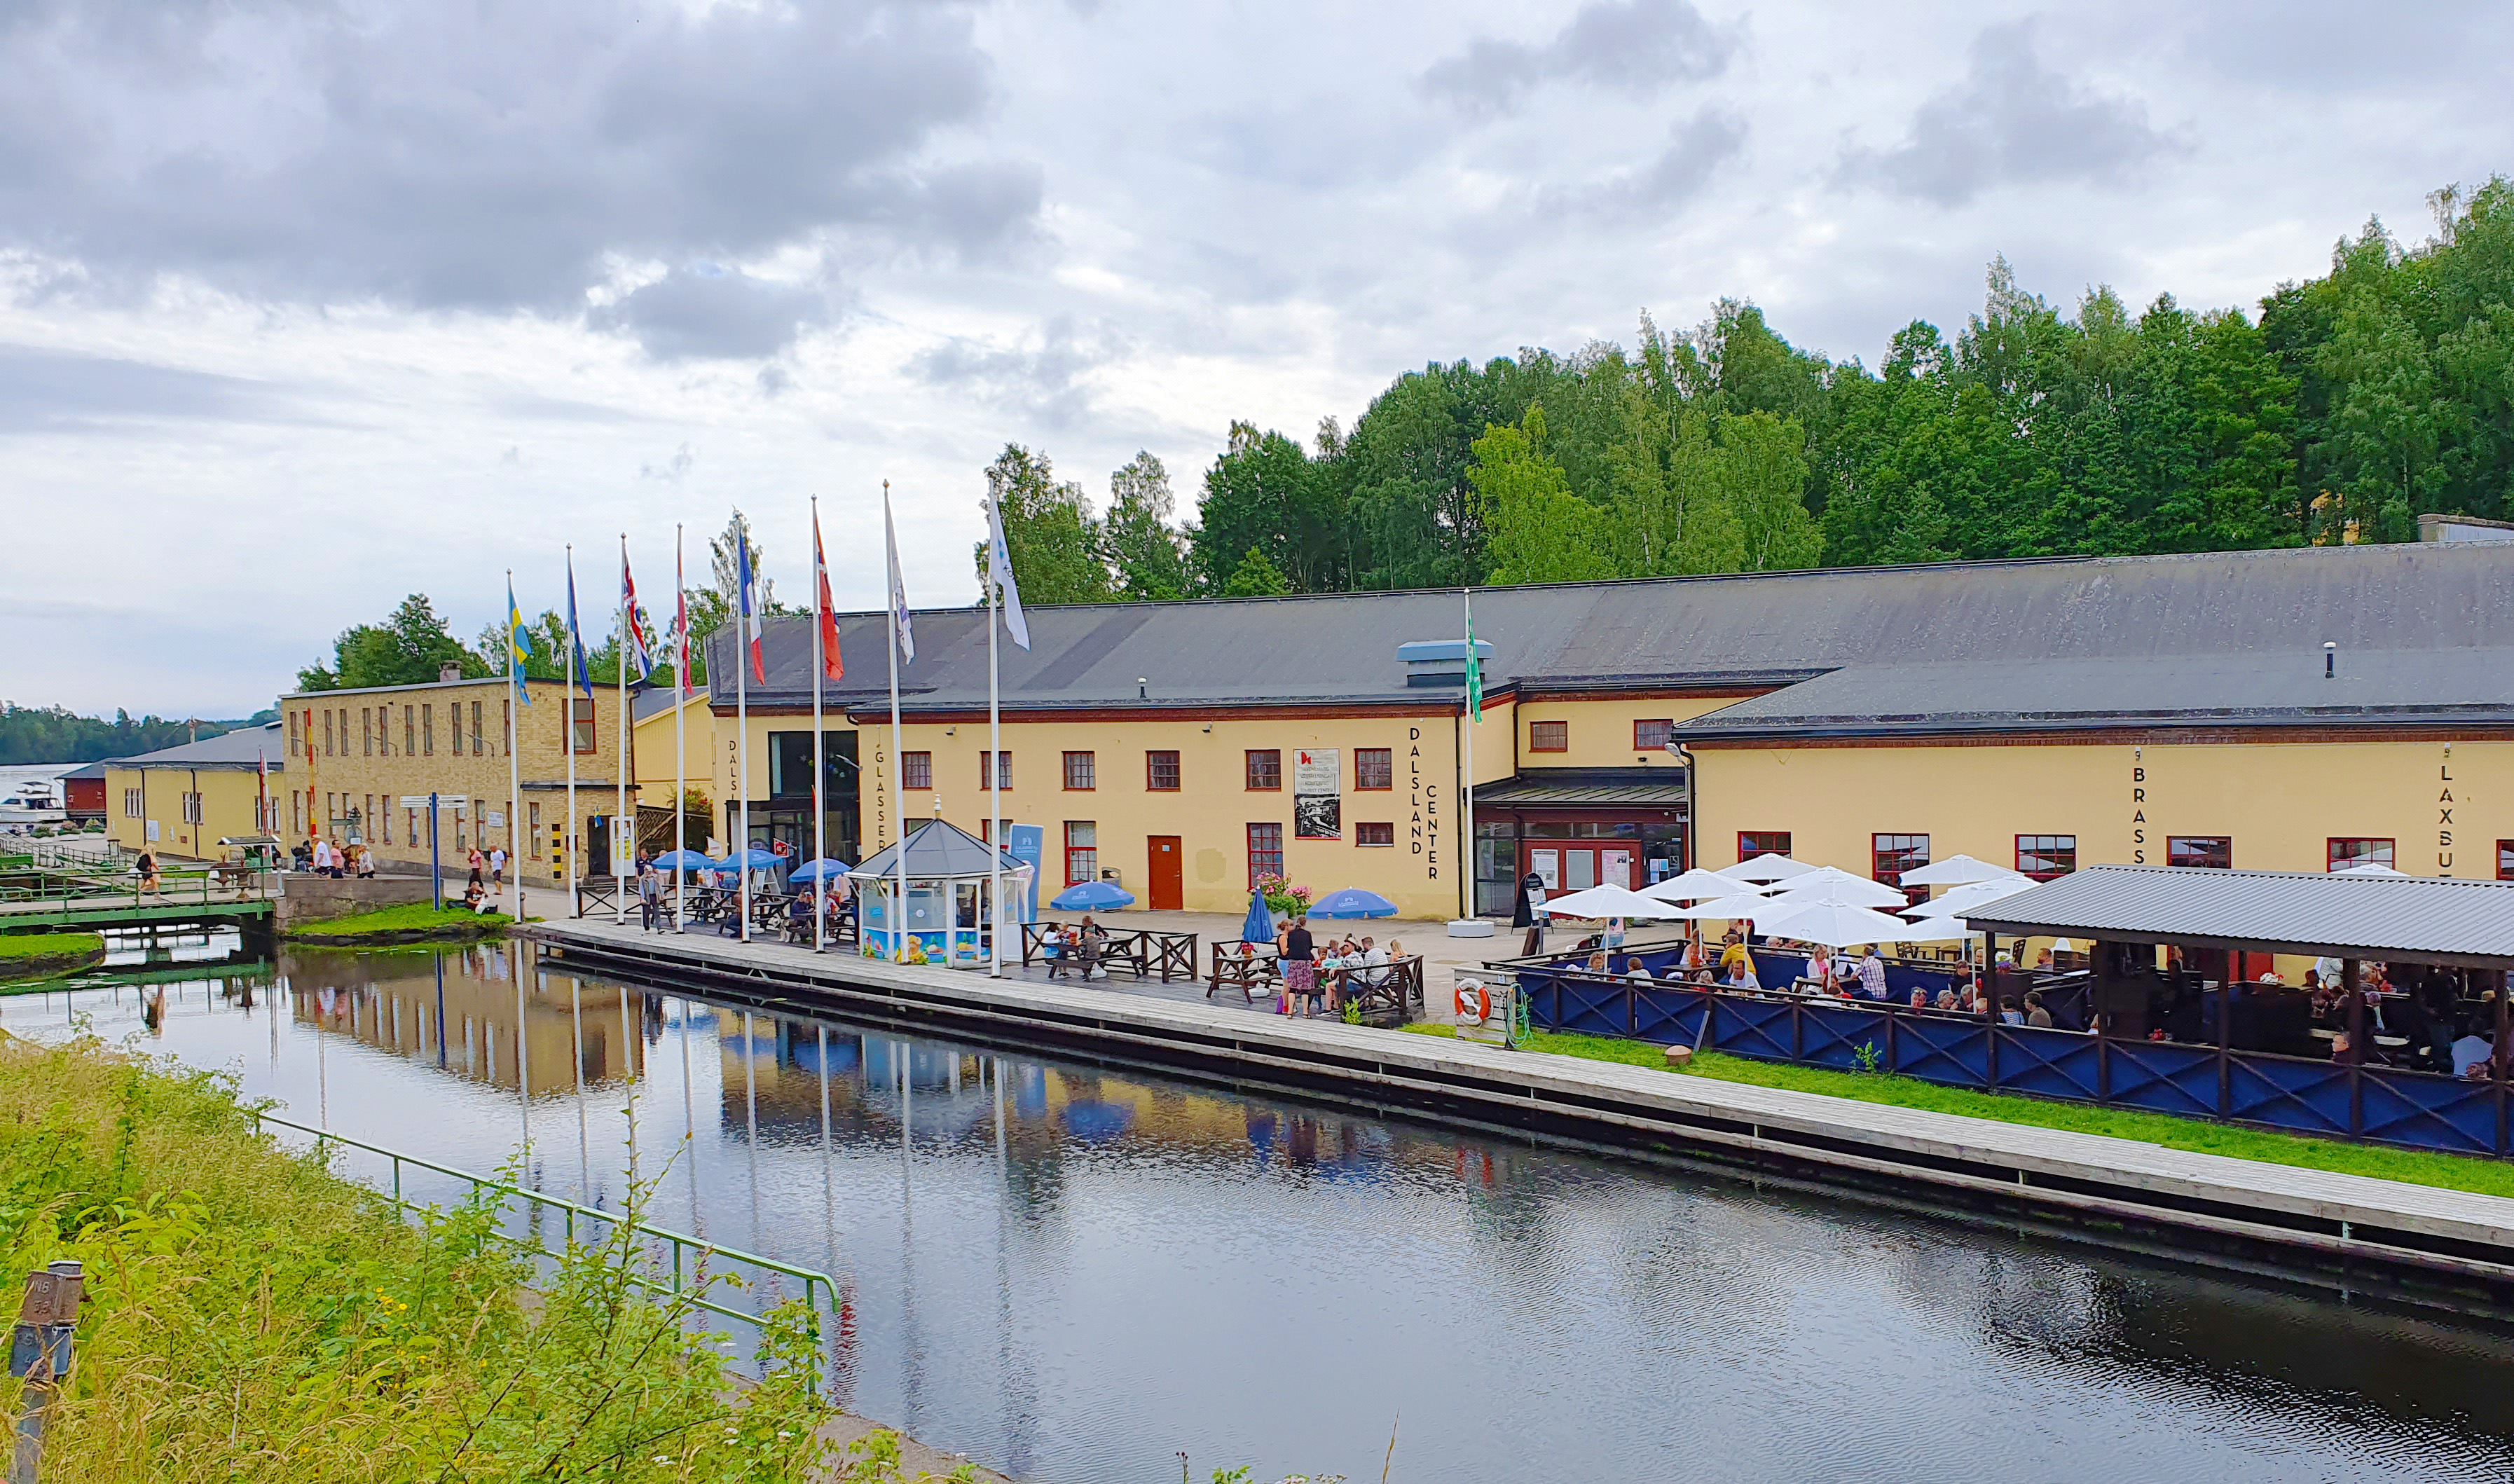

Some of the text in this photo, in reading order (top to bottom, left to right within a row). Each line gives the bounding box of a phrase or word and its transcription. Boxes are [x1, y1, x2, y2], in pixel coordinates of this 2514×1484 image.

[1410, 727, 1422, 854] DALSLAND
[1427, 785, 1438, 880] CENTER
[2133, 767, 2145, 864] BRASS
[2439, 766, 2454, 877] LAXBU
